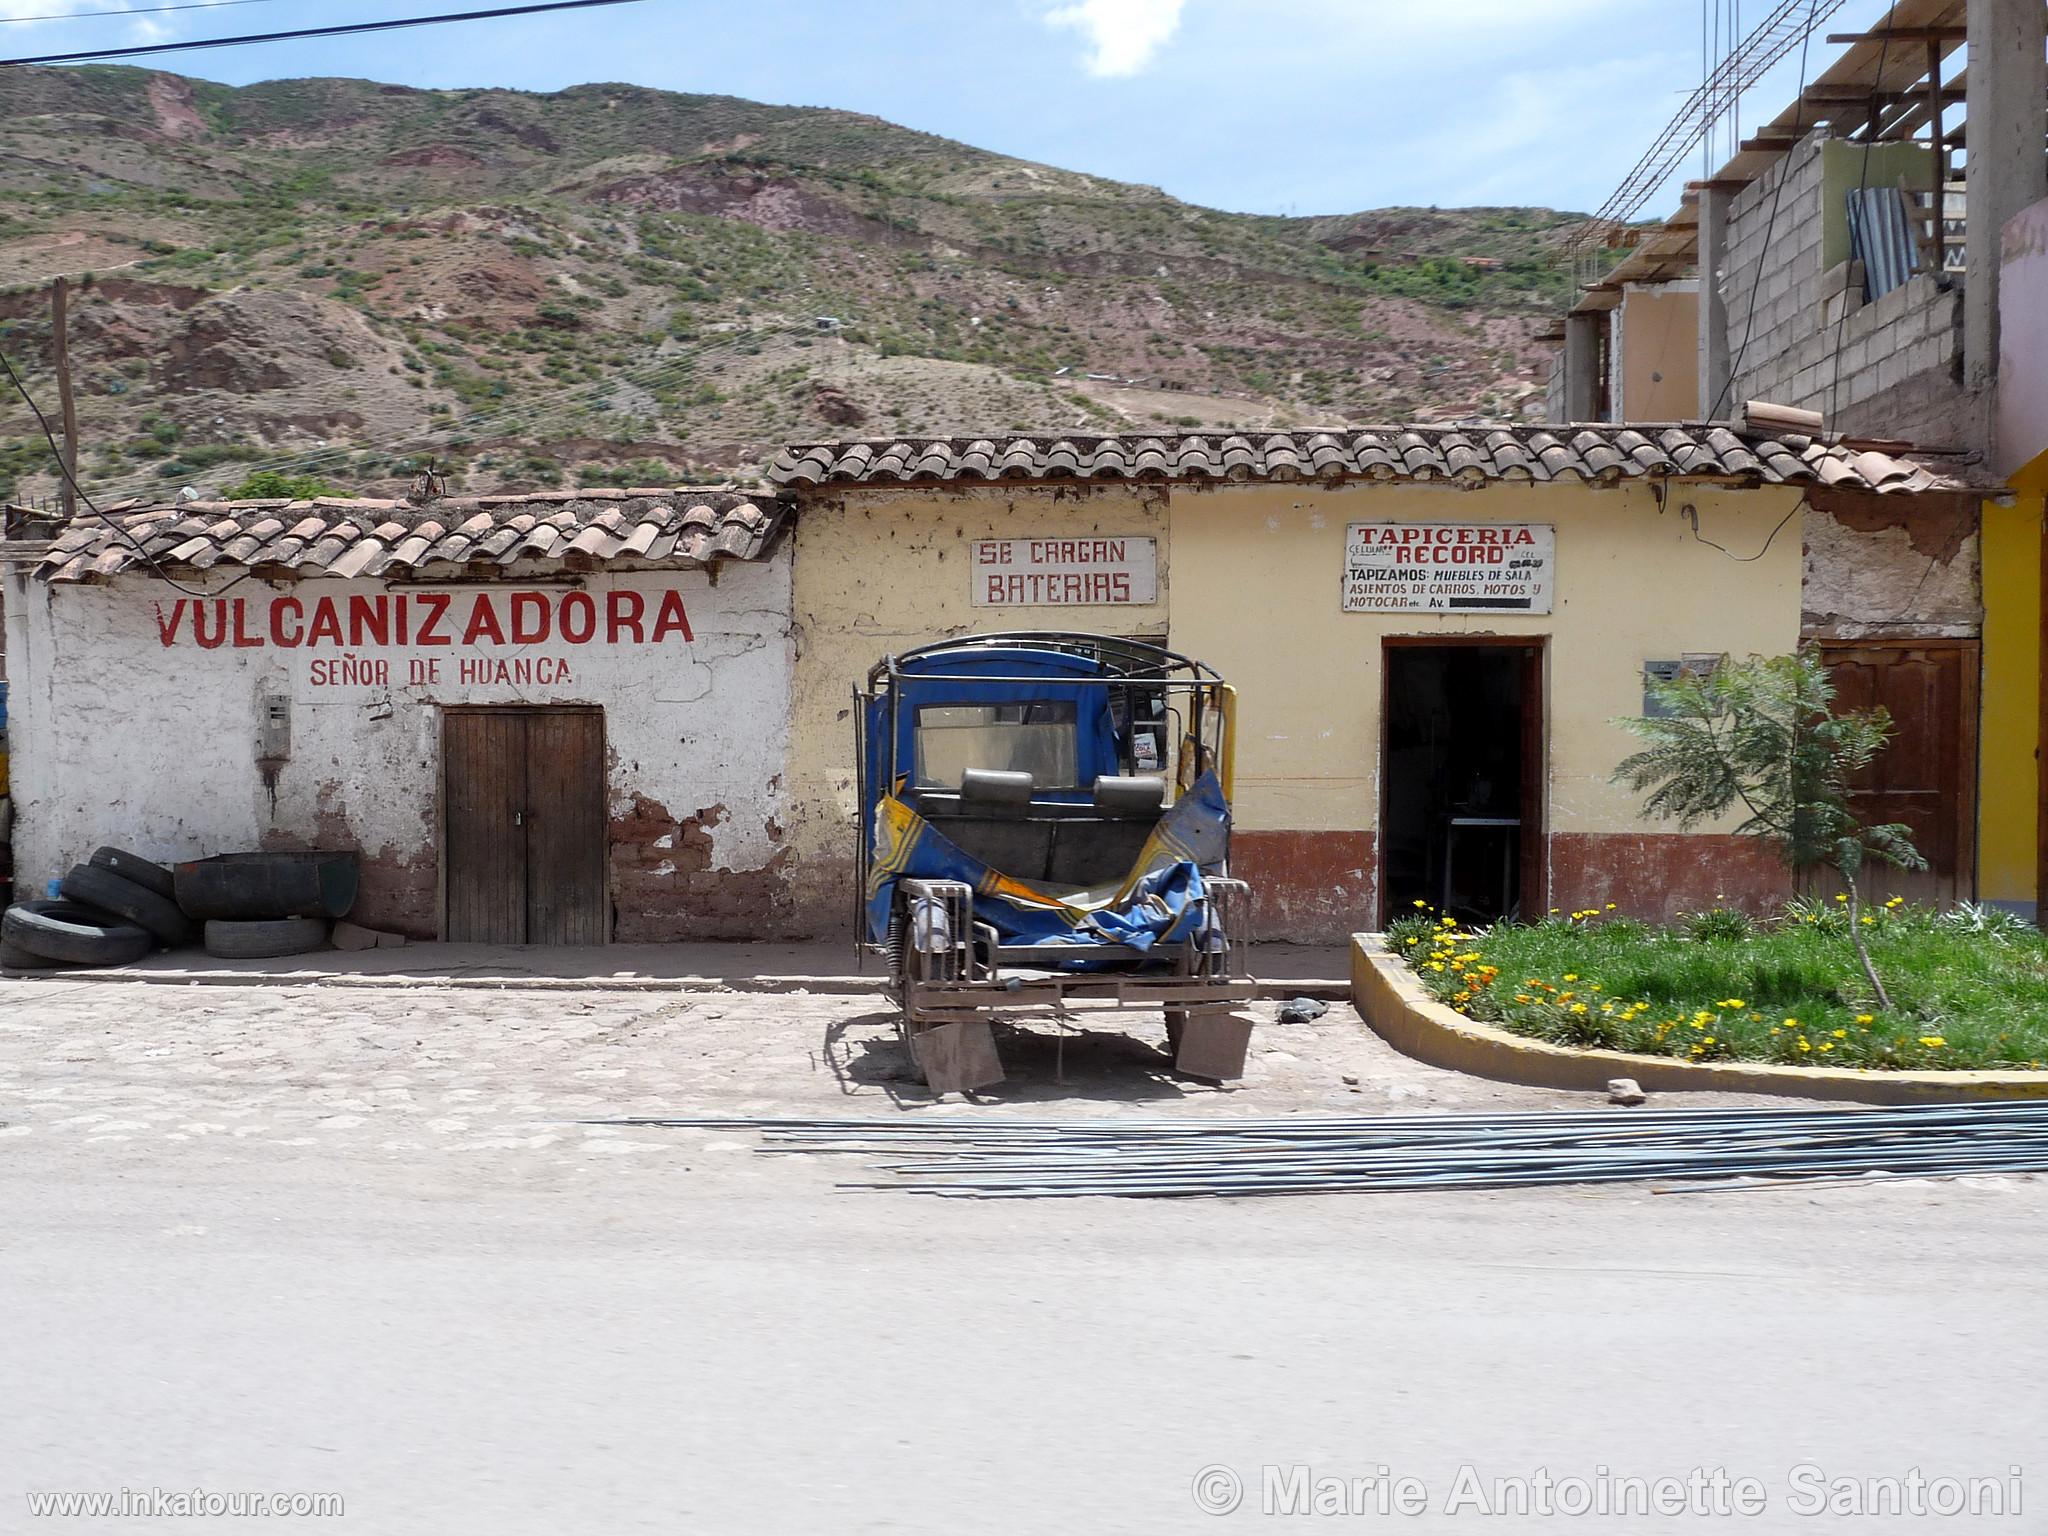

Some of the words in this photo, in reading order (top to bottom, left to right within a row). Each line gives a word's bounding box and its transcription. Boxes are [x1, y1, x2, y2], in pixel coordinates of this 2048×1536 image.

[1358, 528, 1535, 545] TAPICERIA
[979, 542, 1012, 564] SE
[1030, 540, 1125, 564] CARGAN
[1349, 568, 1429, 581] TAPIZAMOS:
[1434, 570, 1484, 581] MUEBLES
[1488, 570, 1502, 581] DE
[1505, 570, 1532, 581] SALA
[987, 572, 1130, 603] BATERIAS
[1349, 583, 1407, 594] ASIENTOS
[1412, 583, 1426, 594] DE
[1484, 584, 1526, 595] MOTOS
[1349, 597, 1408, 608] MOTOCAR
[156, 589, 695, 649] VULCANIZADORA
[310, 653, 389, 687] SEÑOR
[409, 658, 441, 686] DE
[460, 656, 572, 687] HUANCA
